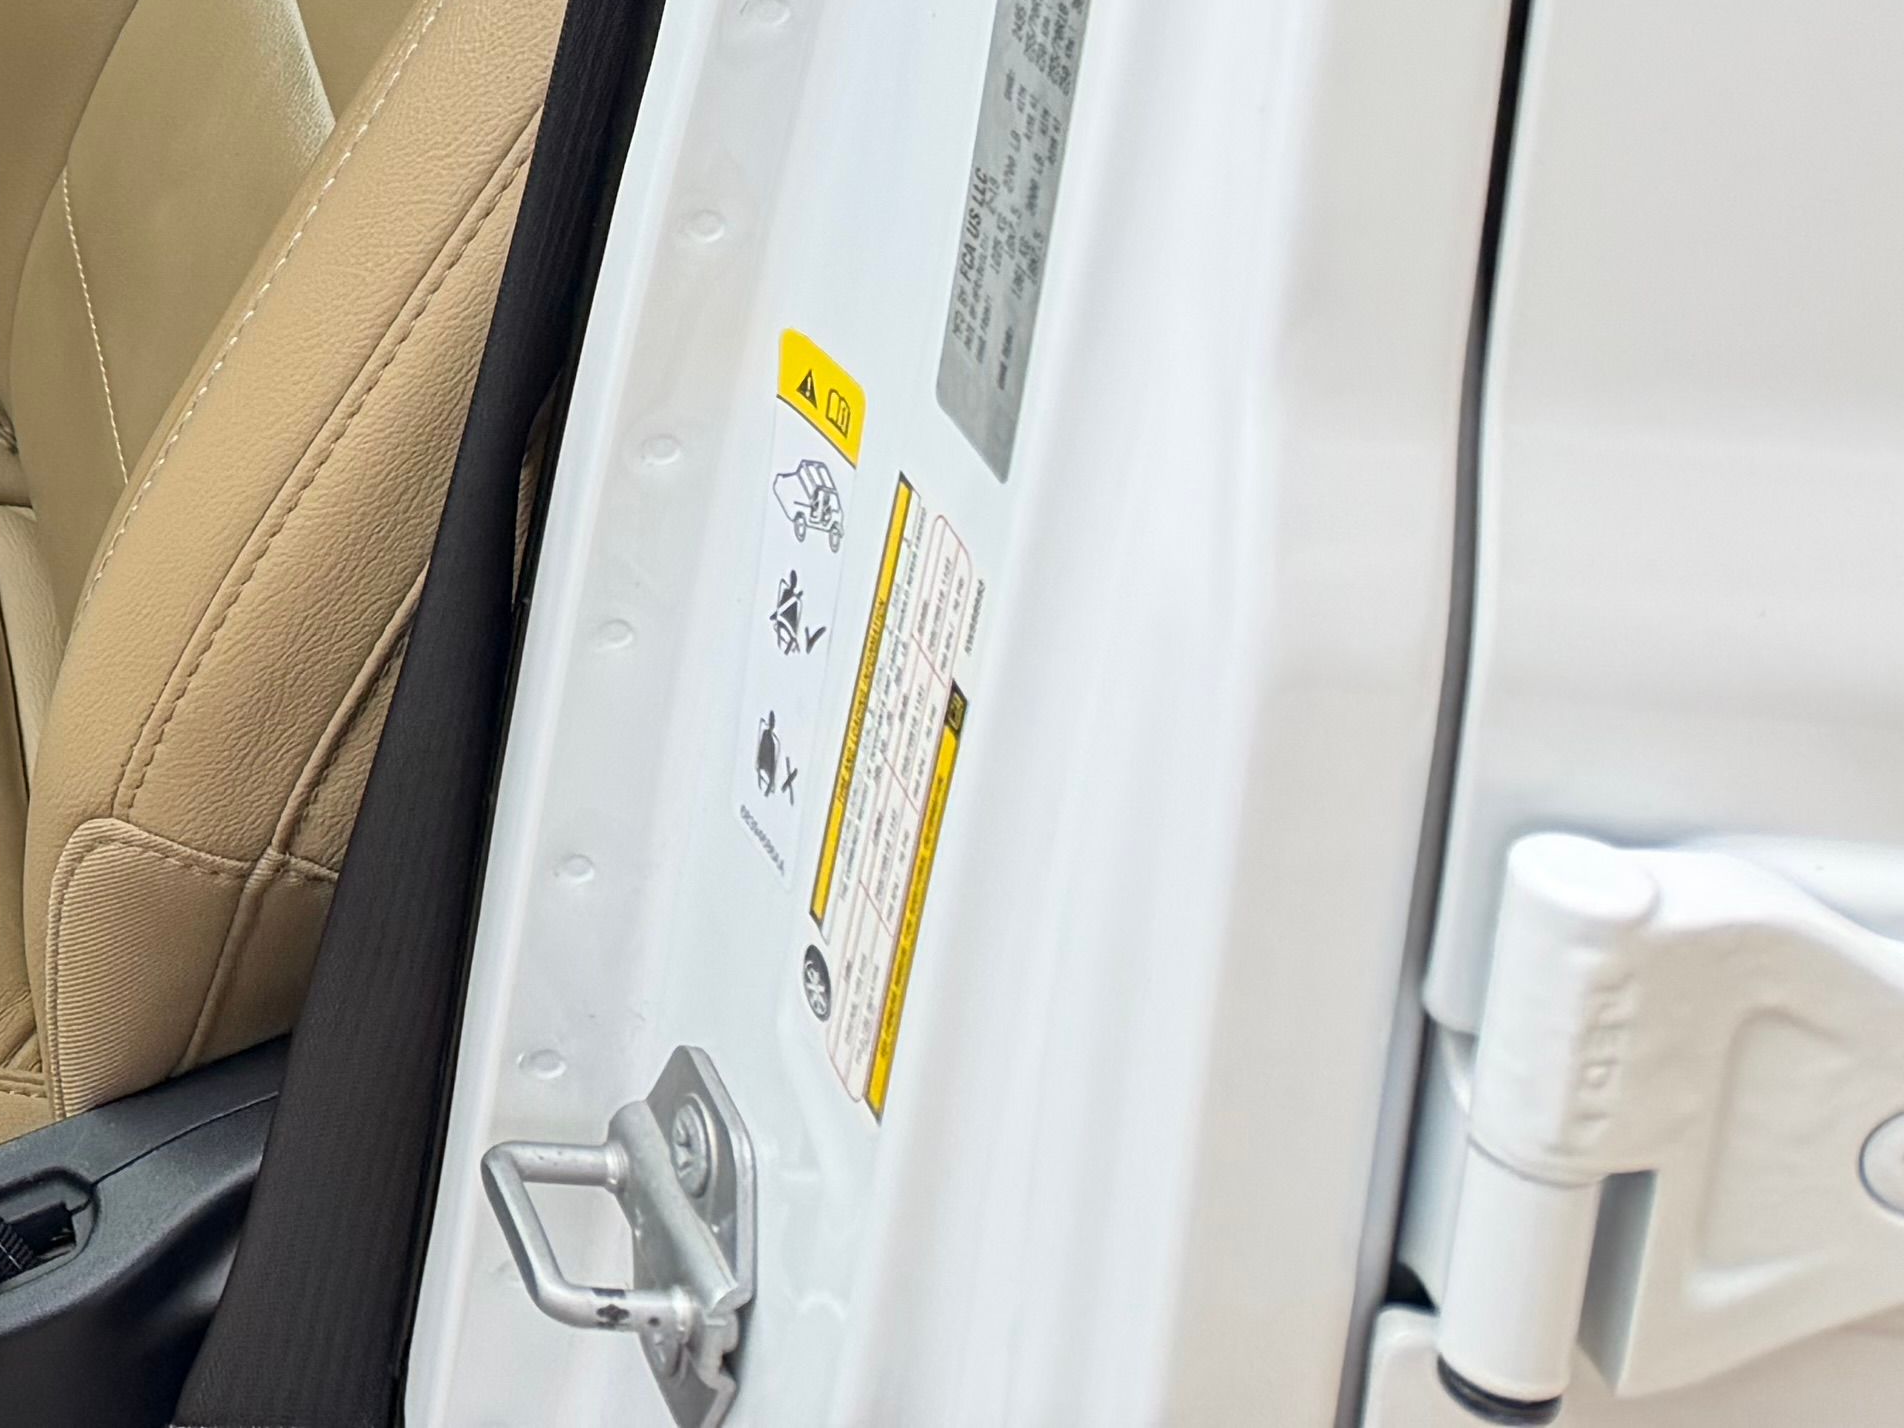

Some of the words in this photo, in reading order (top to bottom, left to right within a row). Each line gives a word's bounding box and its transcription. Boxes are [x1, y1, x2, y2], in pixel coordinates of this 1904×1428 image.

[971, 163, 988, 209] LLC
[965, 204, 981, 242] US
[959, 236, 976, 285] FCA
